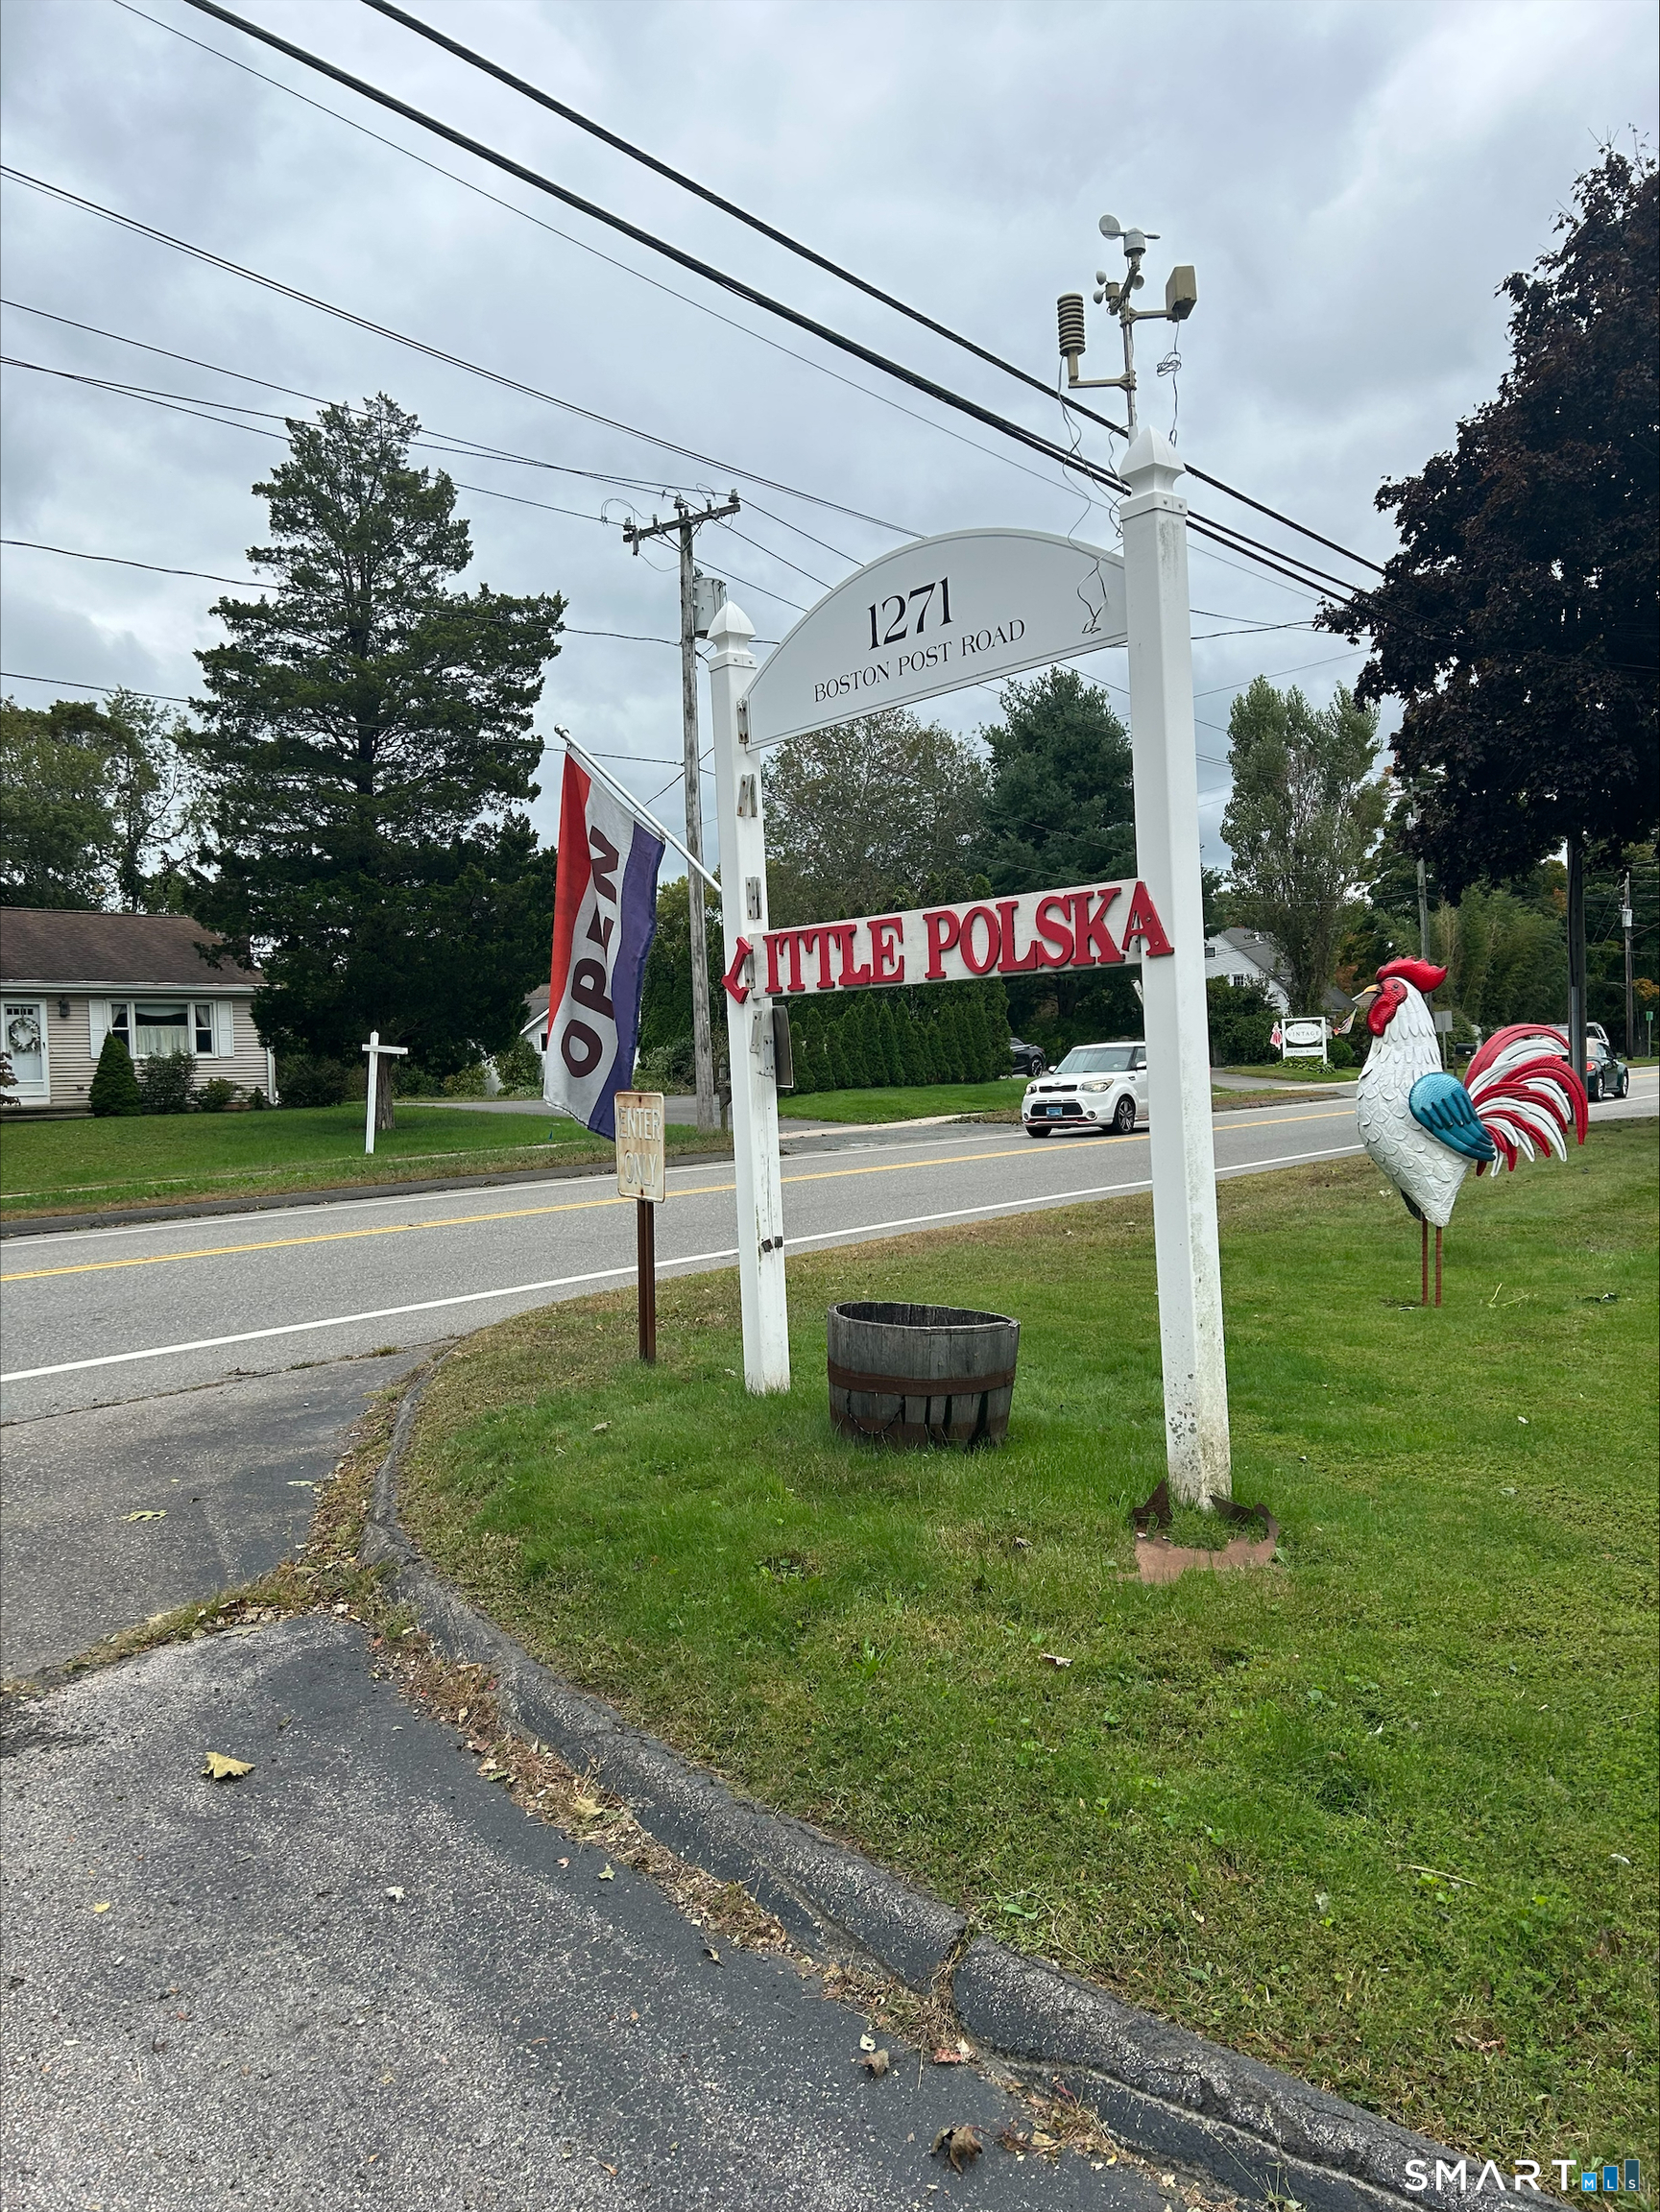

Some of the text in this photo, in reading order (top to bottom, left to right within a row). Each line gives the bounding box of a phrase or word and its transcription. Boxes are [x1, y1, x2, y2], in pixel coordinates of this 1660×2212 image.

[867, 576, 954, 651] 1271
[813, 618, 1026, 703] BOSTON POST ROAD
[721, 880, 1174, 1004] LITTLE POLSKA
[618, 1106, 661, 1142] ENTER
[624, 1151, 658, 1187] ONLY
